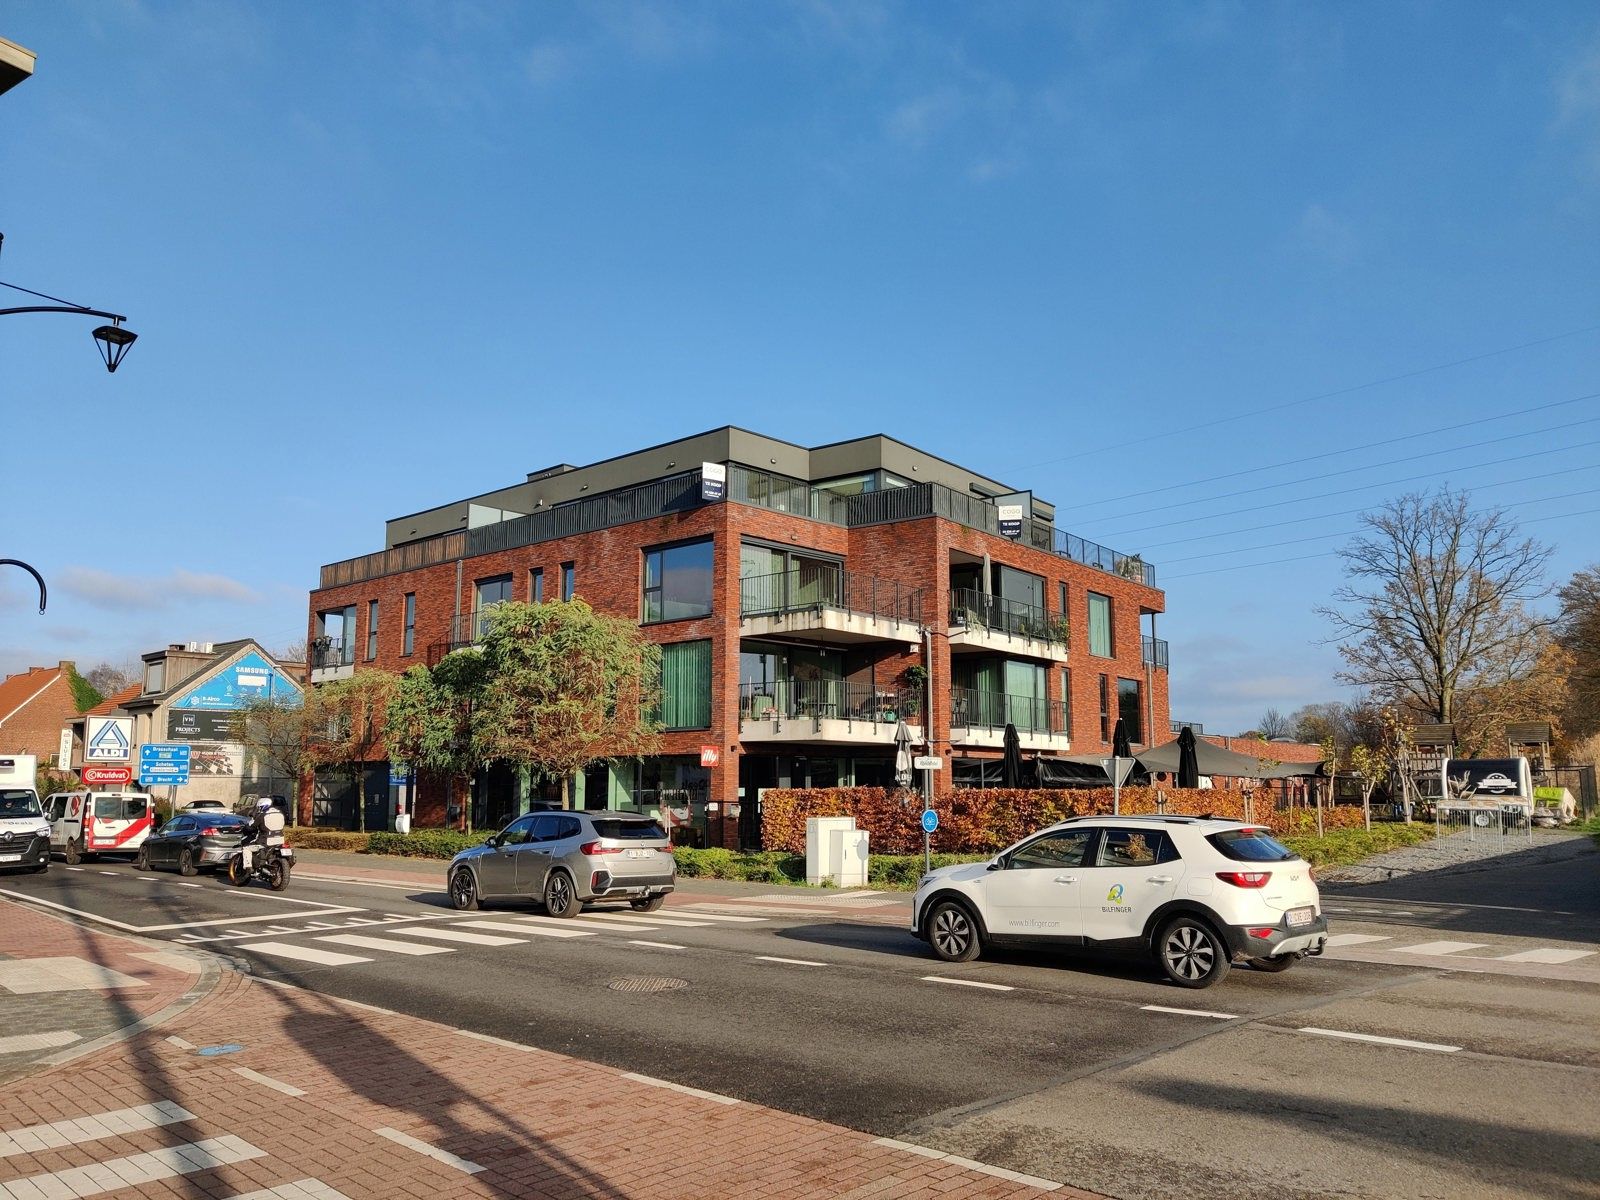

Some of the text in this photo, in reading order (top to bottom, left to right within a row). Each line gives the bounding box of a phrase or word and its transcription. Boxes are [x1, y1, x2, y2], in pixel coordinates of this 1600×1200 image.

[235, 666, 269, 674] SAMSUNG
[92, 748, 124, 757] ALDI
[702, 749, 717, 764] illy
[97, 771, 126, 779] Kruidvat
[1008, 919, 1061, 929] www.bilfinger.com
